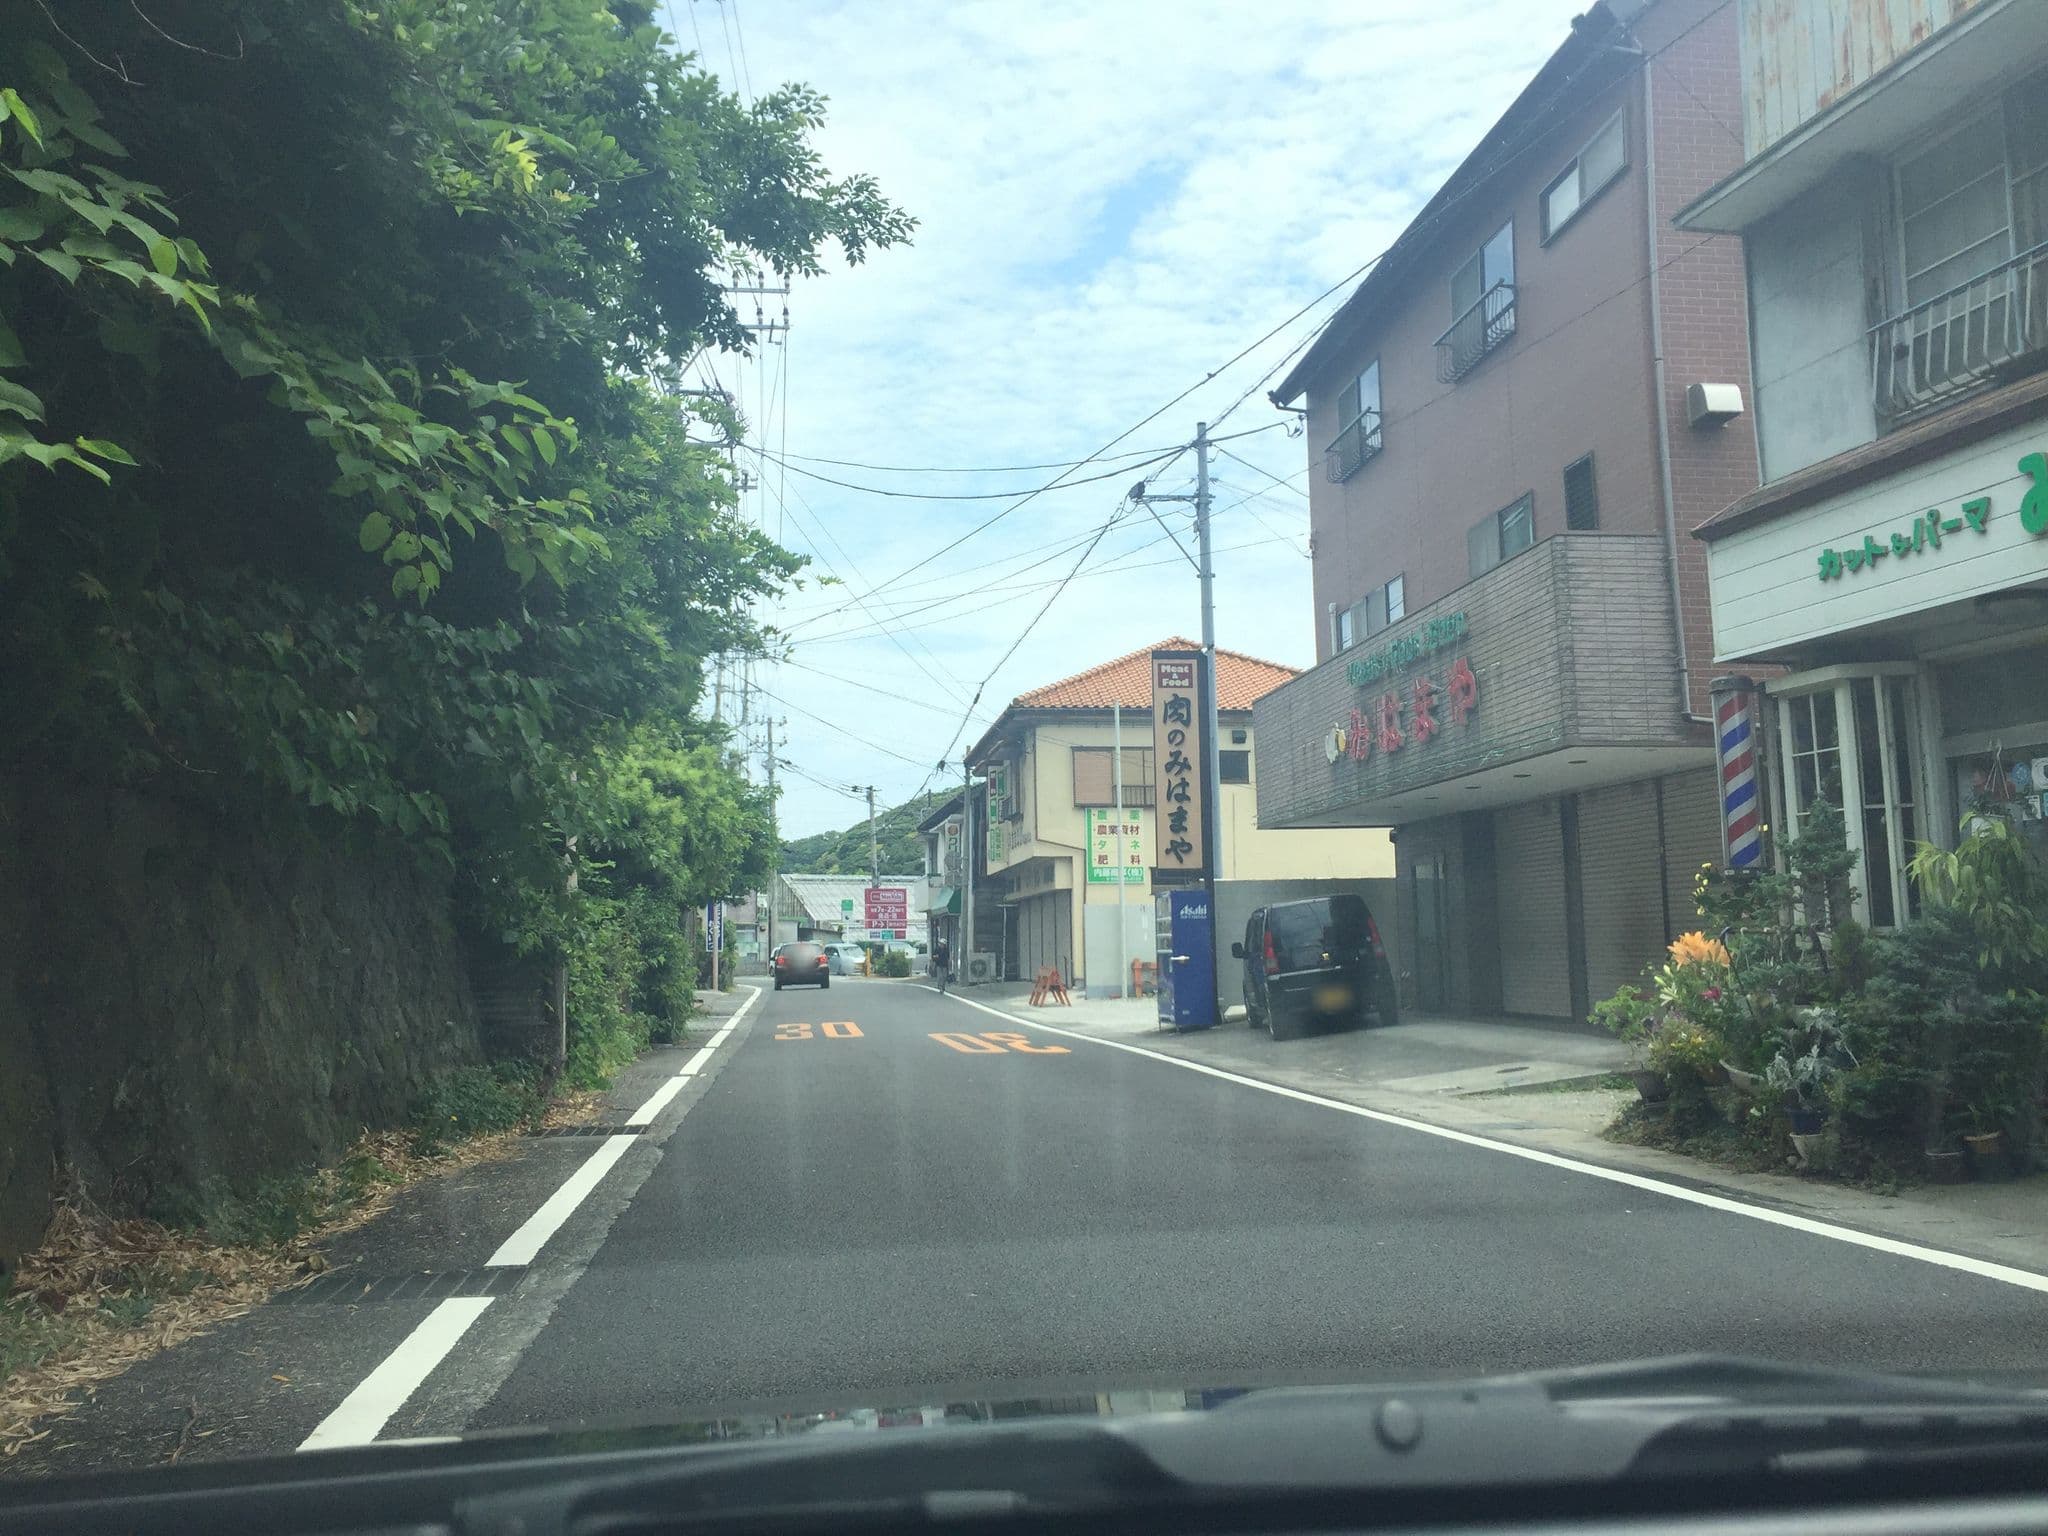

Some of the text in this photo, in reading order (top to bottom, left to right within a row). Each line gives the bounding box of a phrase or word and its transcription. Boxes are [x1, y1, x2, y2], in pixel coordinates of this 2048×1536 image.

[1818, 496, 1992, 581] カット&パーマ
[1160, 664, 1190, 674] Meat
[1161, 678, 1190, 687] Food
[1163, 693, 1193, 864] 肉のみはまや
[1180, 903, 1207, 915] Asahi
[775, 1021, 865, 1040] 30
